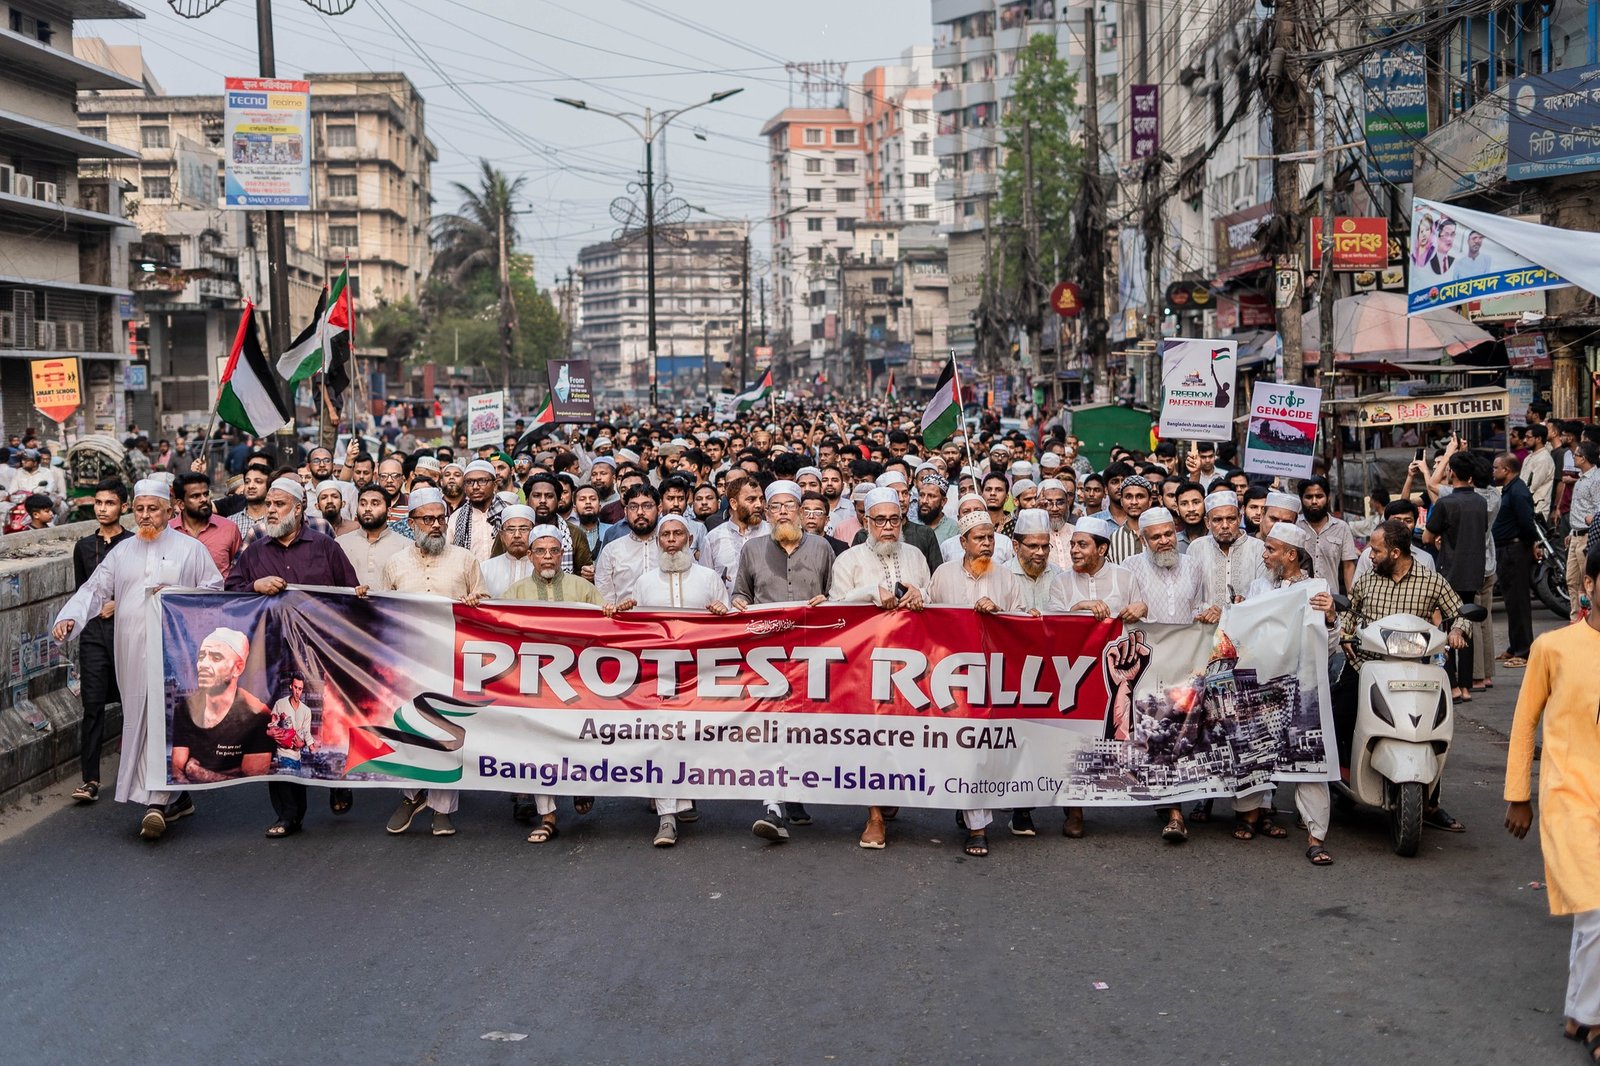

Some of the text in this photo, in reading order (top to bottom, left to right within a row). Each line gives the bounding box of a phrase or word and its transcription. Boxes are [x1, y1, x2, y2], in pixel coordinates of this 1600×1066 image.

[230, 96, 265, 106] TECNO
[272, 99, 302, 107] realme
[1543, 88, 1588, 112] বাংলাদেশ
[1529, 130, 1556, 157] সিটি
[1440, 275, 1500, 300] মোহাম্মদ
[570, 376, 585, 384] From
[58, 394, 77, 402] STOP
[1171, 390, 1213, 398] FREEDOM
[1269, 392, 1305, 408] STOP
[1169, 399, 1214, 408] PALESTINE
[1433, 399, 1503, 416] KITCHEN
[1257, 406, 1313, 420] GENOCIDE
[1252, 458, 1275, 466] Bangladesh
[461, 640, 1098, 712] PROTEST RALLY
[579, 718, 1017, 749] Against Israeli massacre in GAZA
[479, 755, 1063, 796] Bangladesh Jamaat-e-Islami, Chattogram City
